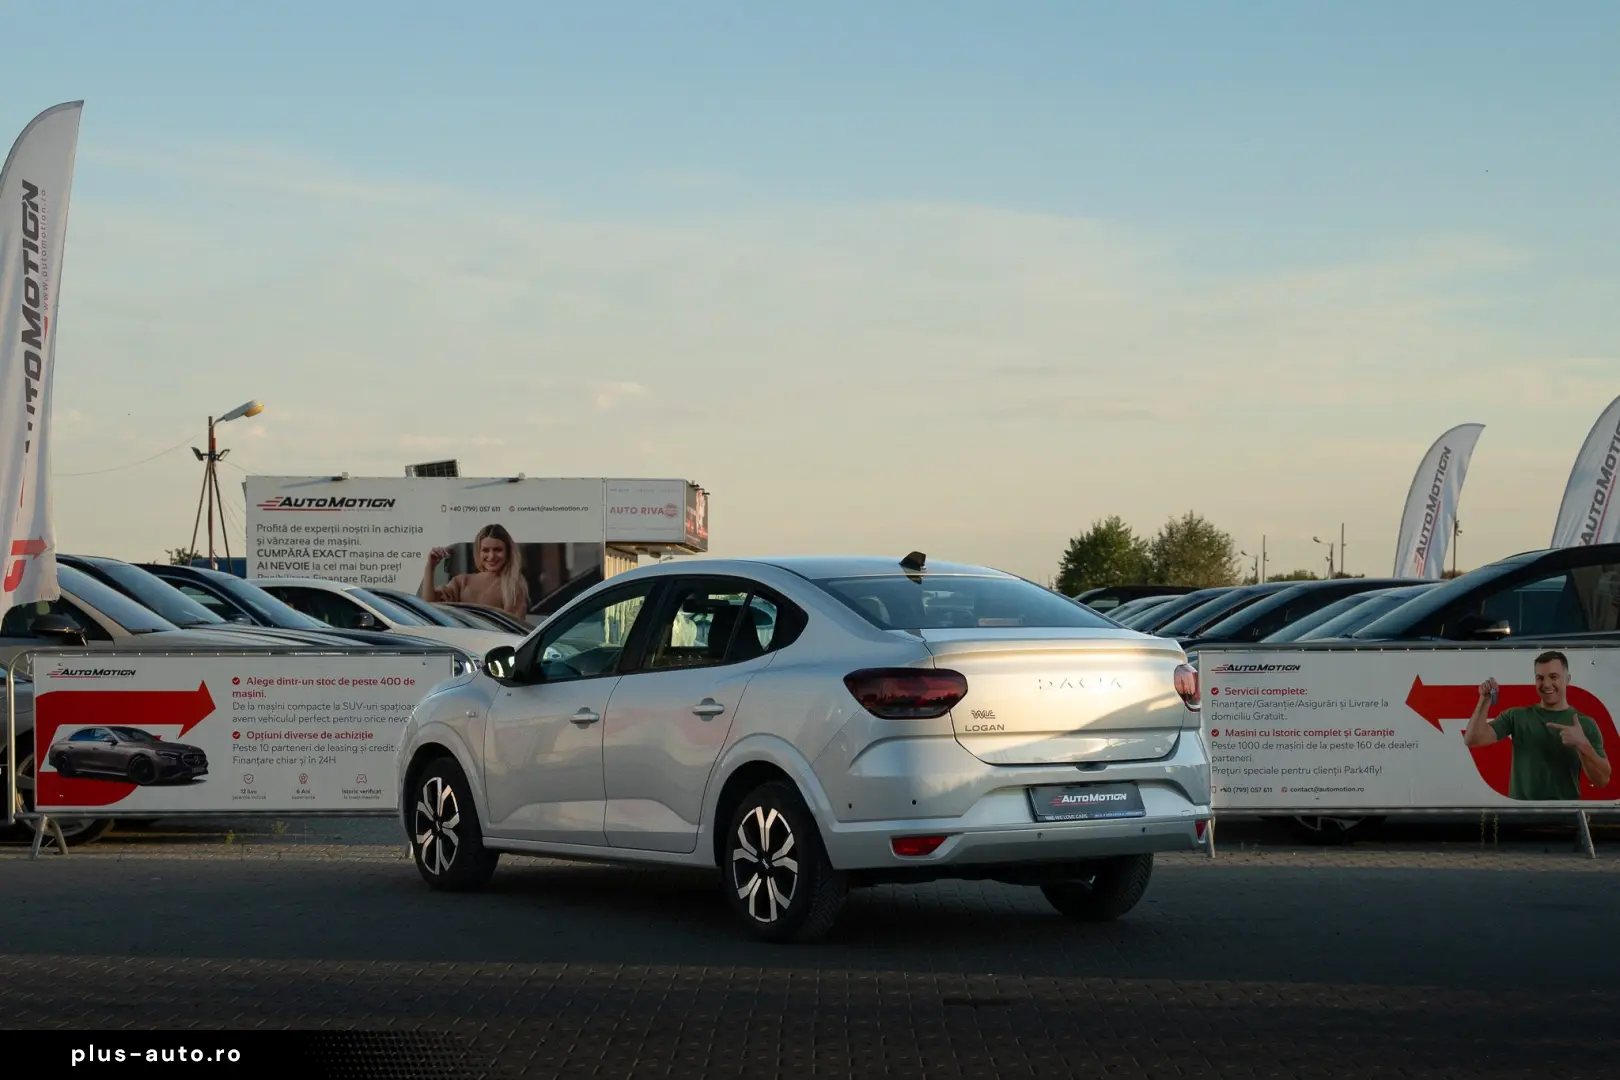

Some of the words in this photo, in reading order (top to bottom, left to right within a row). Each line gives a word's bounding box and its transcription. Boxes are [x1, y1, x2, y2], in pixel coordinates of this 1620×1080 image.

[21, 179, 42, 453] TOMOTION
[278, 496, 396, 508] AUTOMOTION
[1415, 446, 1452, 560] AUTOMOTION
[463, 505, 478, 513] (799)
[479, 505, 490, 513] 057
[492, 505, 500, 513] 611
[517, 505, 588, 513] contact@automotion.ro
[609, 506, 638, 515] AUTO
[640, 507, 665, 516] RIVA
[290, 524, 302, 533] de
[313, 536, 325, 546] de
[313, 548, 347, 559] EXACT
[387, 549, 398, 559] de
[401, 551, 421, 559] care
[257, 560, 268, 571] AI
[270, 561, 309, 571] NEVOIE
[312, 561, 320, 571] la
[323, 562, 336, 571] cel
[340, 562, 356, 571] mai
[360, 561, 378, 571] bun
[61, 668, 136, 676] AUTOMOTION
[1226, 663, 1301, 672] AUTOMOTION
[247, 676, 274, 688] Alege
[277, 676, 313, 686] dintr-un
[316, 678, 336, 686] stoc
[338, 677, 349, 686] de
[352, 678, 378, 688] peste
[380, 677, 401, 686] 400
[404, 677, 415, 686] de
[1225, 686, 1259, 696] Servicii
[1261, 686, 1307, 697] complete:
[233, 701, 245, 711] De
[248, 701, 255, 711] la
[288, 703, 331, 713] compacte
[334, 701, 340, 711] la
[342, 701, 377, 711] SUV-uri
[1349, 699, 1379, 708] Livrare
[1382, 698, 1388, 708] la
[258, 713, 295, 724] vehiculul
[299, 713, 330, 725] perfect
[333, 715, 362, 725] pentru
[364, 714, 386, 724] orice
[1211, 711, 1250, 721] domiciliu
[1253, 711, 1287, 721] Gratuit.
[964, 724, 1005, 732] LOGAN
[284, 730, 318, 740] diverse
[321, 730, 332, 740] de
[1273, 728, 1301, 737] Istoric
[1304, 728, 1341, 739] complet
[233, 743, 257, 752] Peste
[260, 743, 269, 752] 10
[272, 743, 311, 755] parteneri
[314, 743, 325, 752] de
[328, 743, 358, 755] leasing
[369, 743, 394, 753] credit
[1212, 740, 1236, 751] Peste
[1238, 740, 1260, 750] 1000
[1262, 740, 1274, 750] de
[1306, 741, 1317, 750] de
[1320, 740, 1327, 750] la
[1330, 741, 1354, 752] peste
[1357, 740, 1372, 750] 160
[1374, 740, 1386, 750] de
[1388, 740, 1418, 750] dealeri
[276, 755, 297, 765] chiar
[319, 755, 336, 765] 24H
[1212, 753, 1253, 764] parteneri.
[1244, 765, 1279, 777] speciale
[1281, 766, 1310, 777] pentru
[1344, 765, 1382, 777] Park4fly!
[1233, 786, 1249, 794] (799)
[1061, 793, 1127, 803] AUTOMOTION
